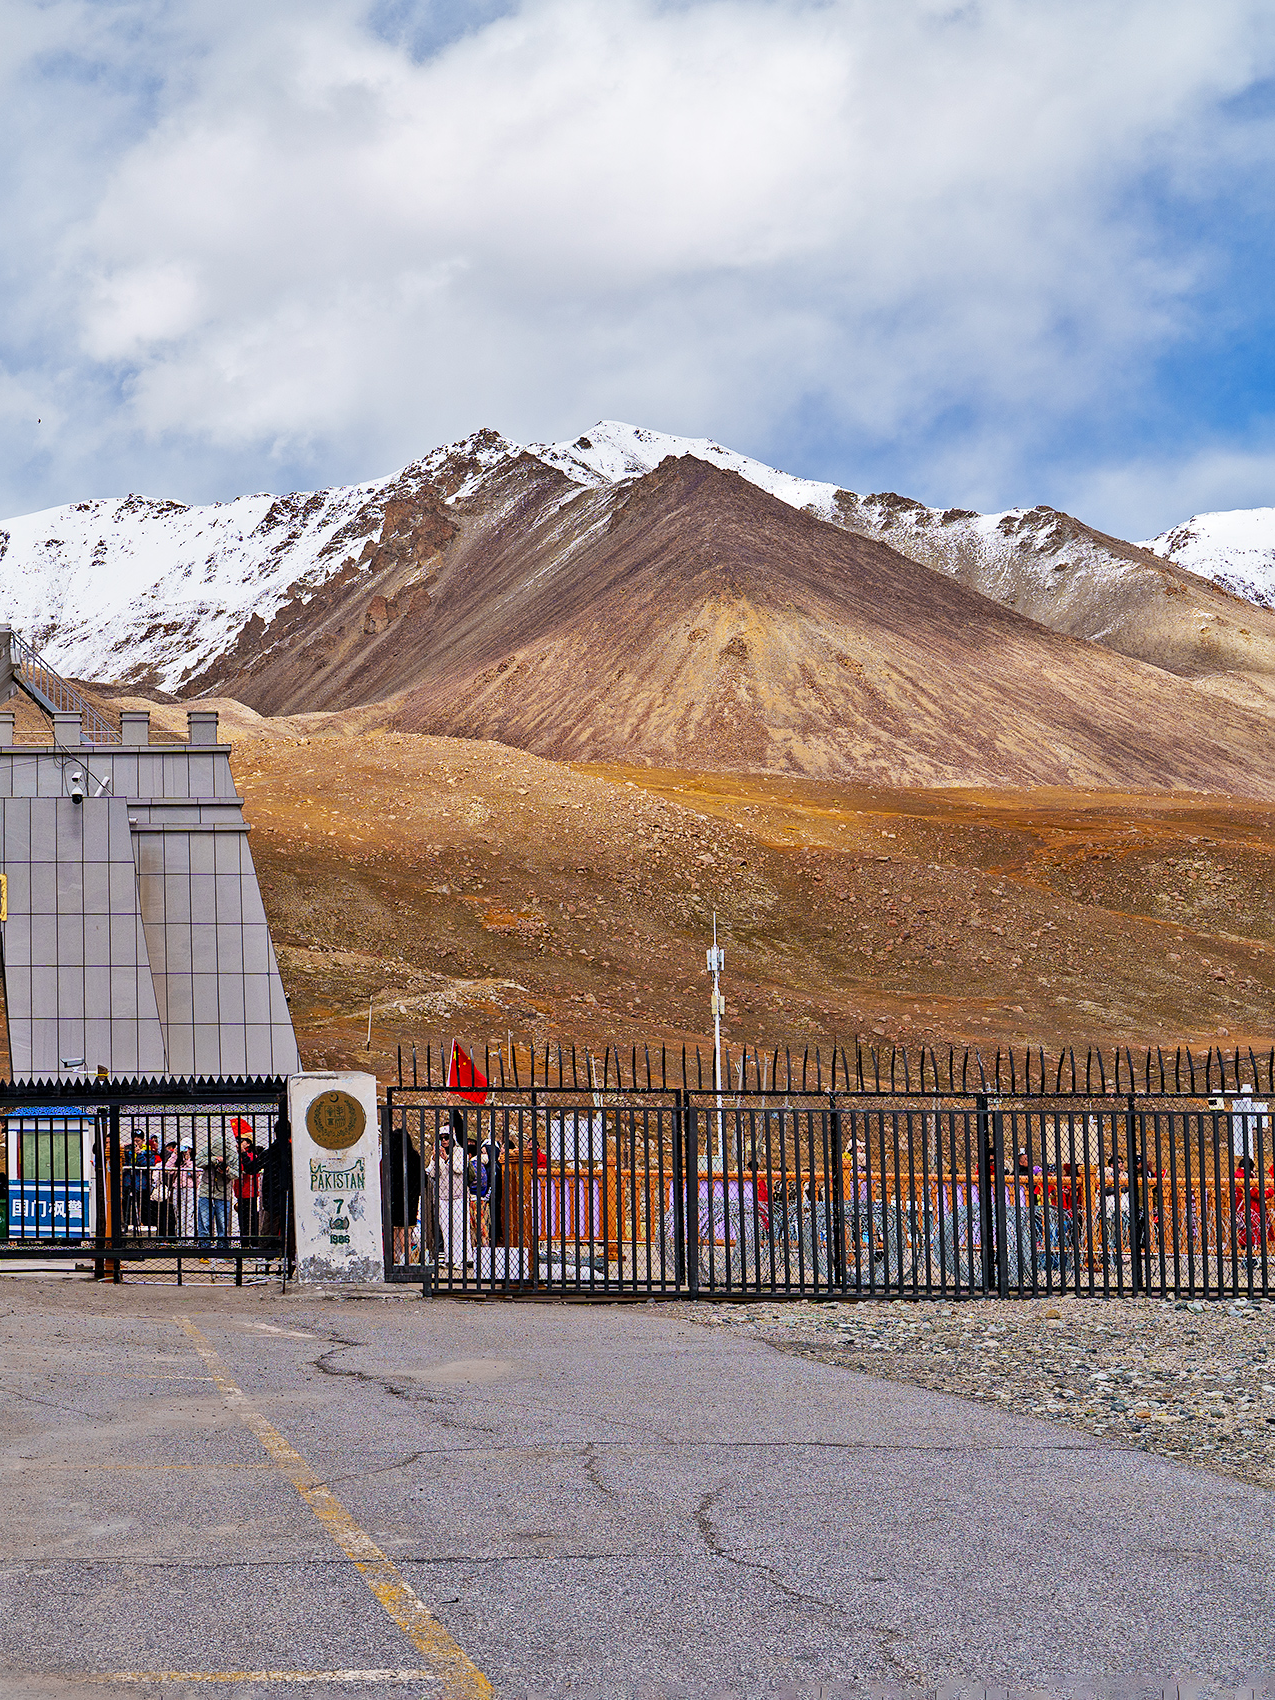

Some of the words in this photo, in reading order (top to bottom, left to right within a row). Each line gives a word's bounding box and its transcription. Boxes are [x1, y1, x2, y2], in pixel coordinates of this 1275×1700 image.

[310, 1173, 365, 1191] PAKISTAN
[333, 1199, 344, 1214] 7
[330, 1234, 350, 1245] 1986
